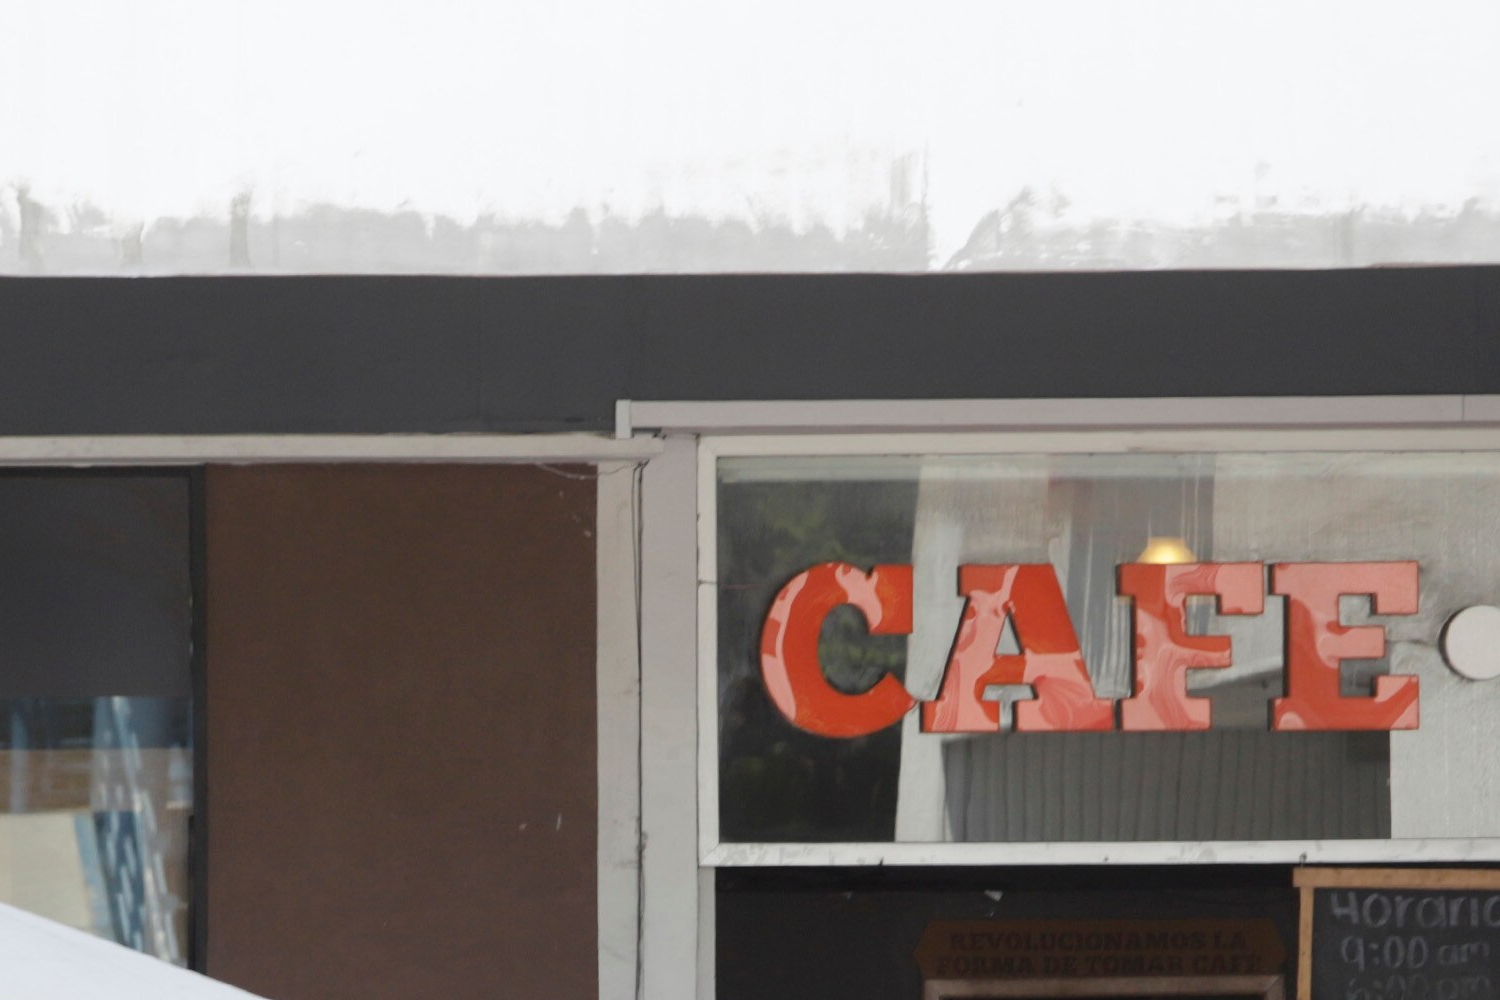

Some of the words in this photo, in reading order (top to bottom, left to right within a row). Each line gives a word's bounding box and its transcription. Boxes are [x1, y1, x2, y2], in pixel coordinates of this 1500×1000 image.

[759, 561, 1420, 738] CAFE
[949, 930, 1206, 951] REVOLUCIONAMOS
[1213, 931, 1247, 951] LA
[936, 954, 1036, 977] FORMA
[1043, 954, 1077, 976] DE
[1085, 954, 1183, 976] TOMAR
